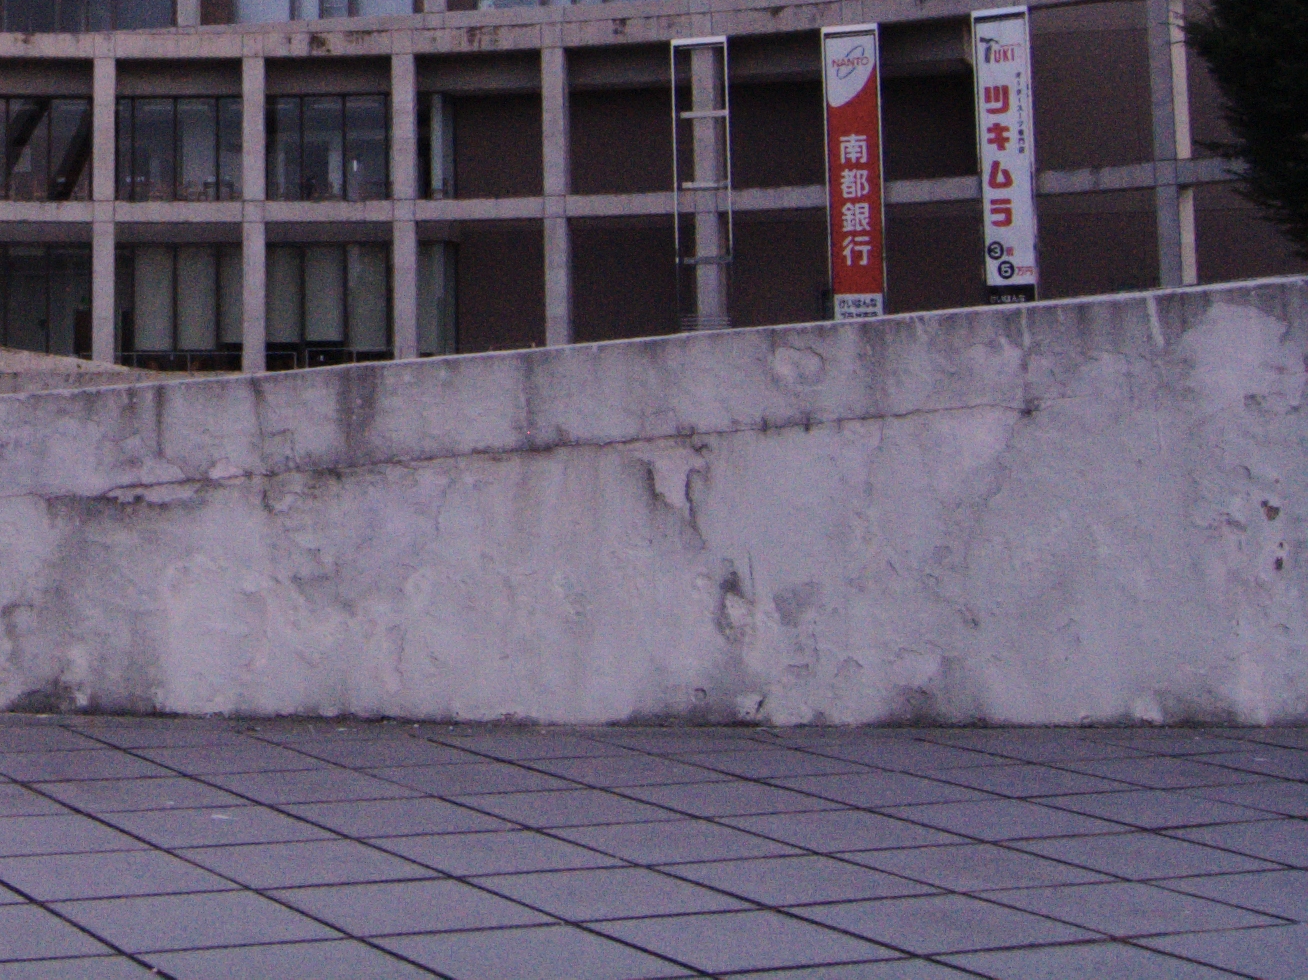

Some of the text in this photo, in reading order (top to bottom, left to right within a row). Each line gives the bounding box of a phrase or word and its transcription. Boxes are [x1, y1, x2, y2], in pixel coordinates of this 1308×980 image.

[832, 56, 870, 68] NANTO
[839, 133, 872, 267] 南都銀行
[984, 84, 1014, 228] ツキムラ
